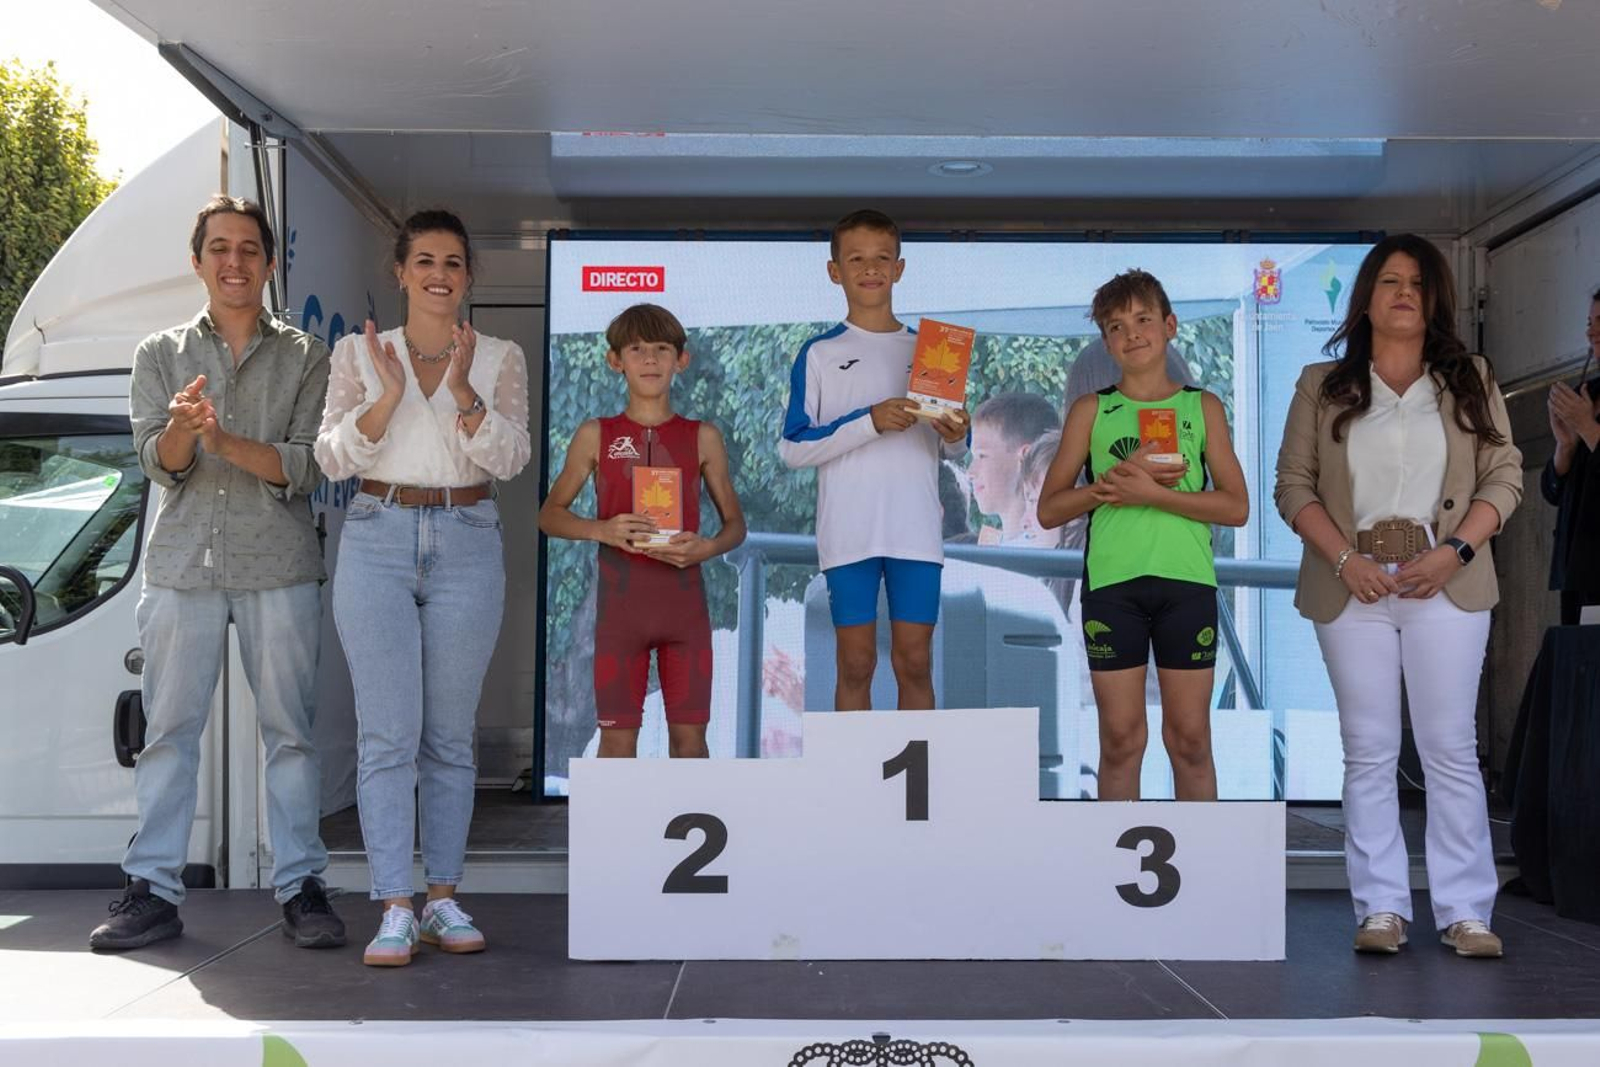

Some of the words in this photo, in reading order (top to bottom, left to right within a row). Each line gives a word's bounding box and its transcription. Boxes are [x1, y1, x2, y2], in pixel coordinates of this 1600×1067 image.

[589, 272, 659, 288] DIRECTO
[883, 741, 928, 820] 1
[662, 814, 727, 893] 2
[1116, 827, 1180, 907] 3
